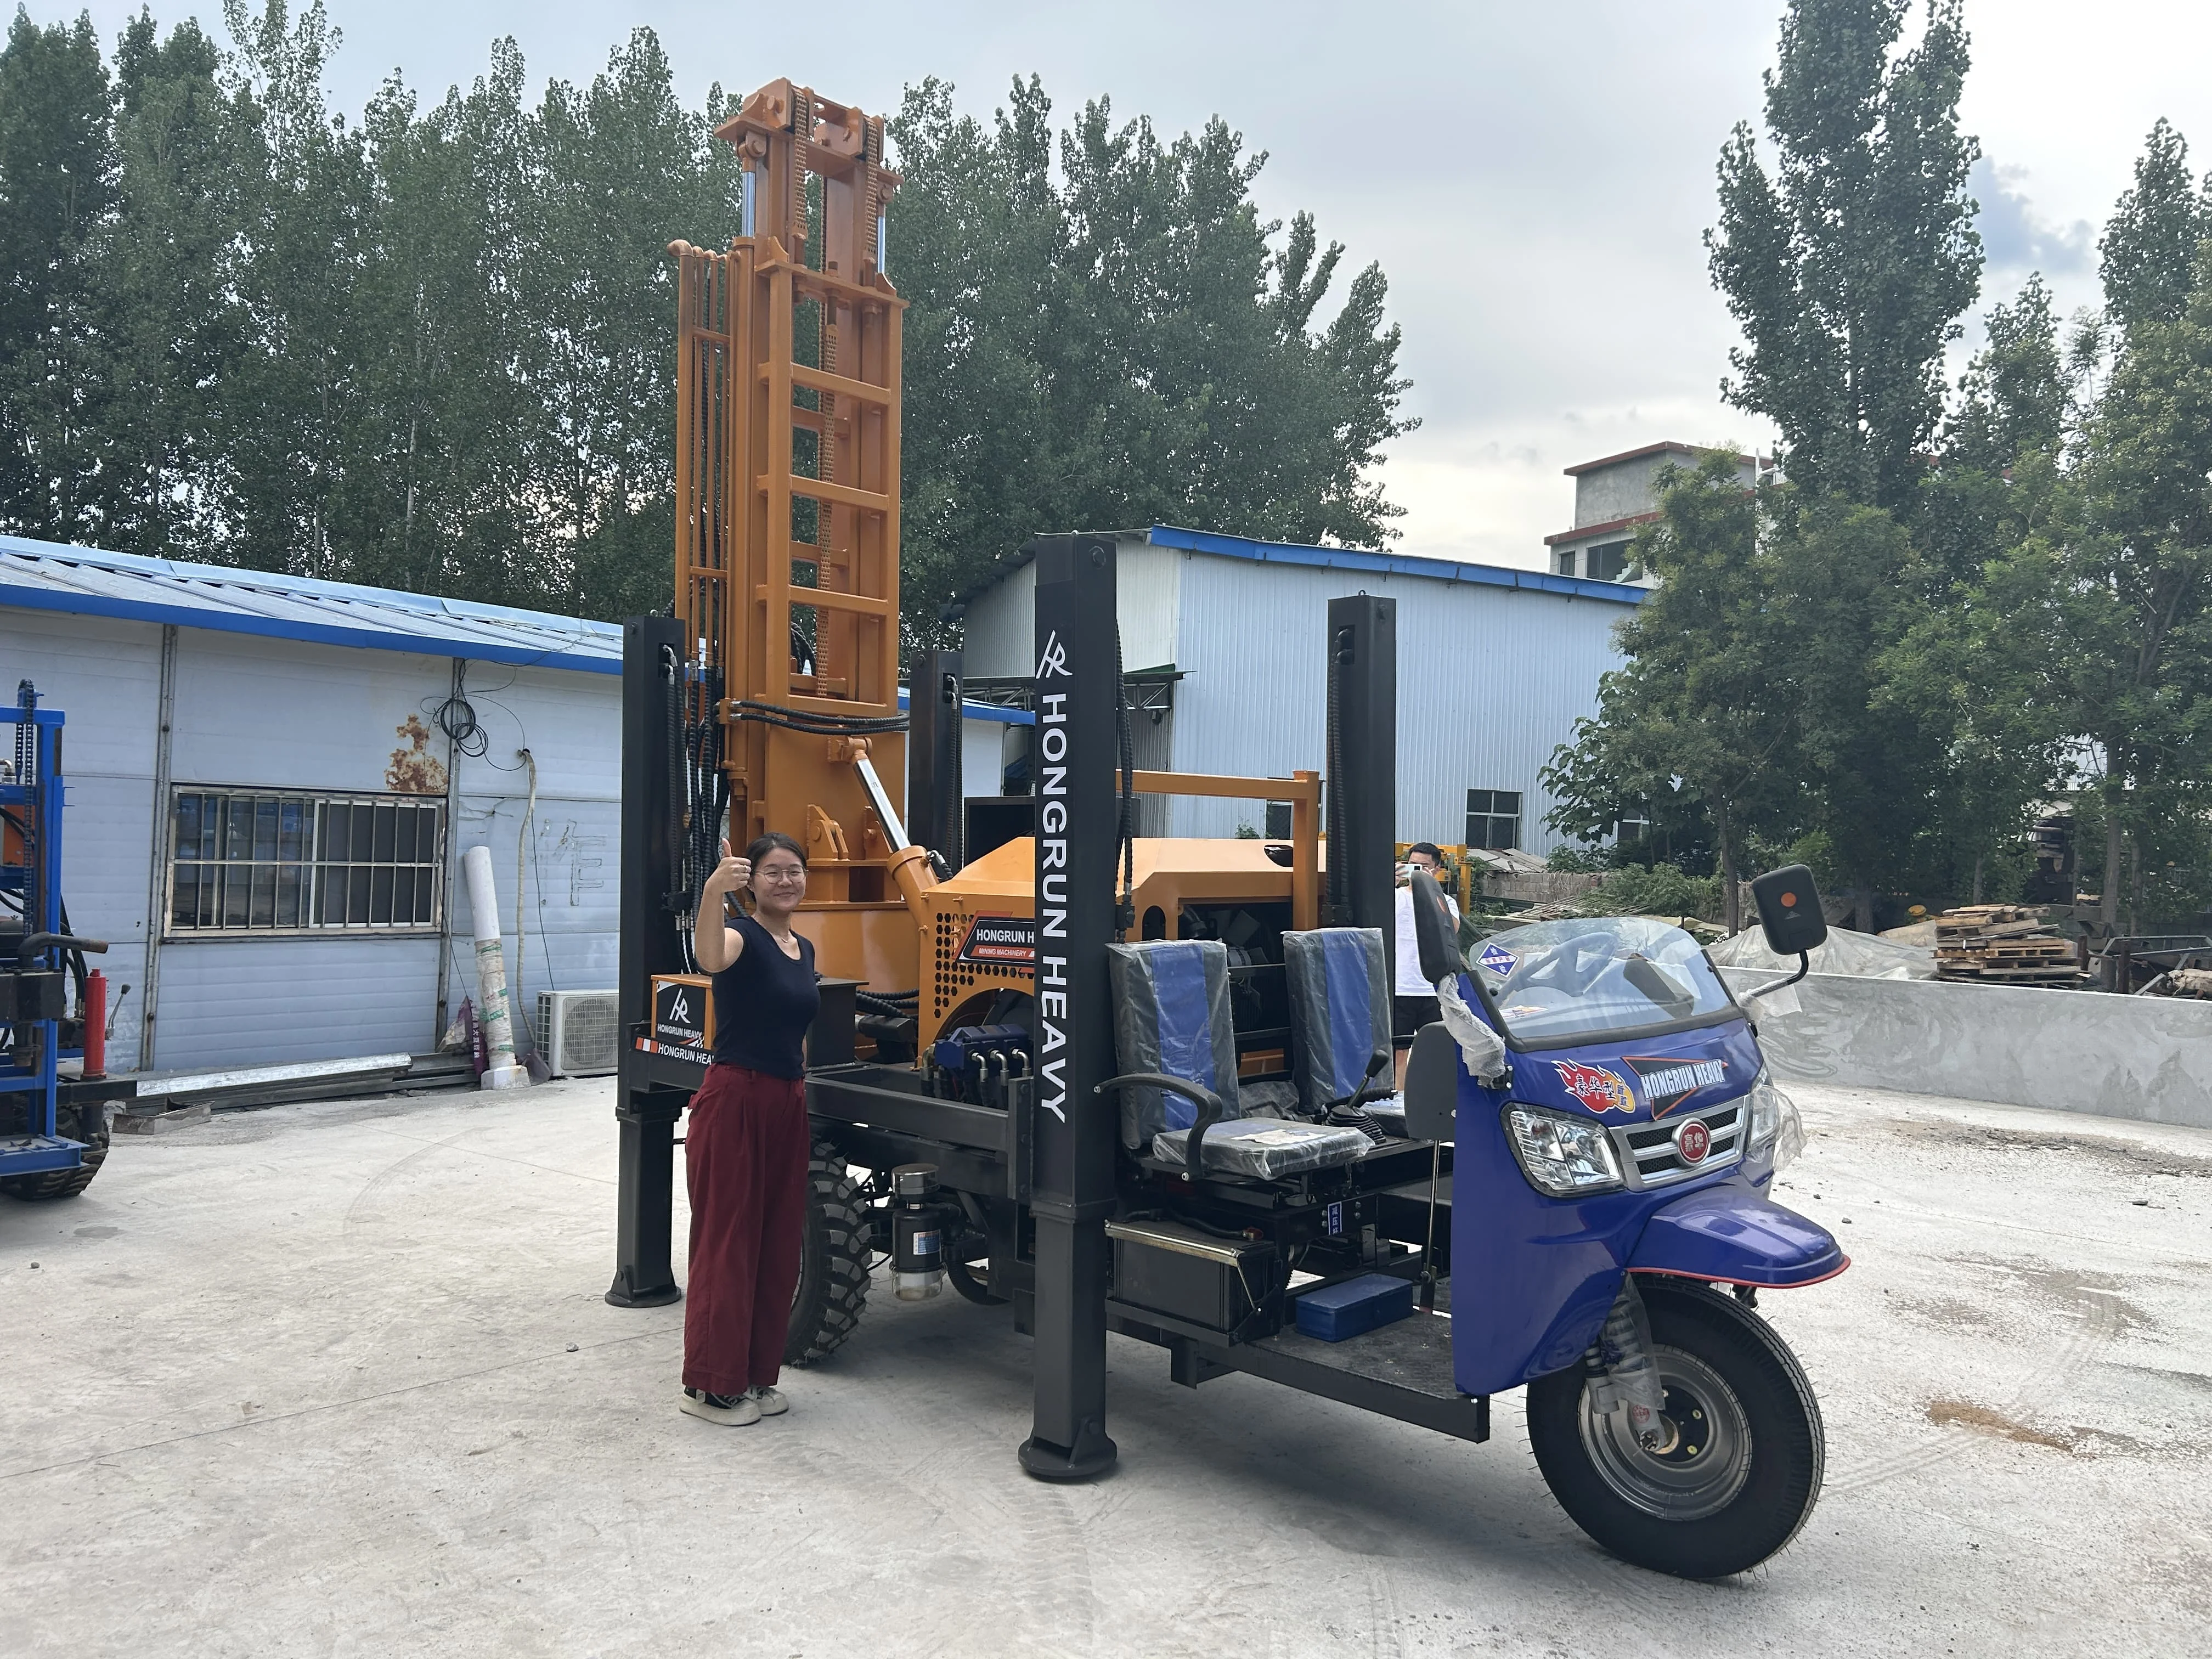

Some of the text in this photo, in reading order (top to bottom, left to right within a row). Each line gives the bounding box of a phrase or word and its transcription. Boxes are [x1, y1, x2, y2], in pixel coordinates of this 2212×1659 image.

[1041, 693, 1067, 1124] HONGRUN HEAVY
[977, 928, 1025, 943] HONGRUN
[996, 949, 1027, 957] MACHINERY
[658, 1023, 703, 1040] HONGRUN HEAVY
[658, 1042, 696, 1062] HONGRUN
[1575, 1074, 1616, 1100] 豪华型
[1640, 1059, 1725, 1100] HONGRUN HEAVY
